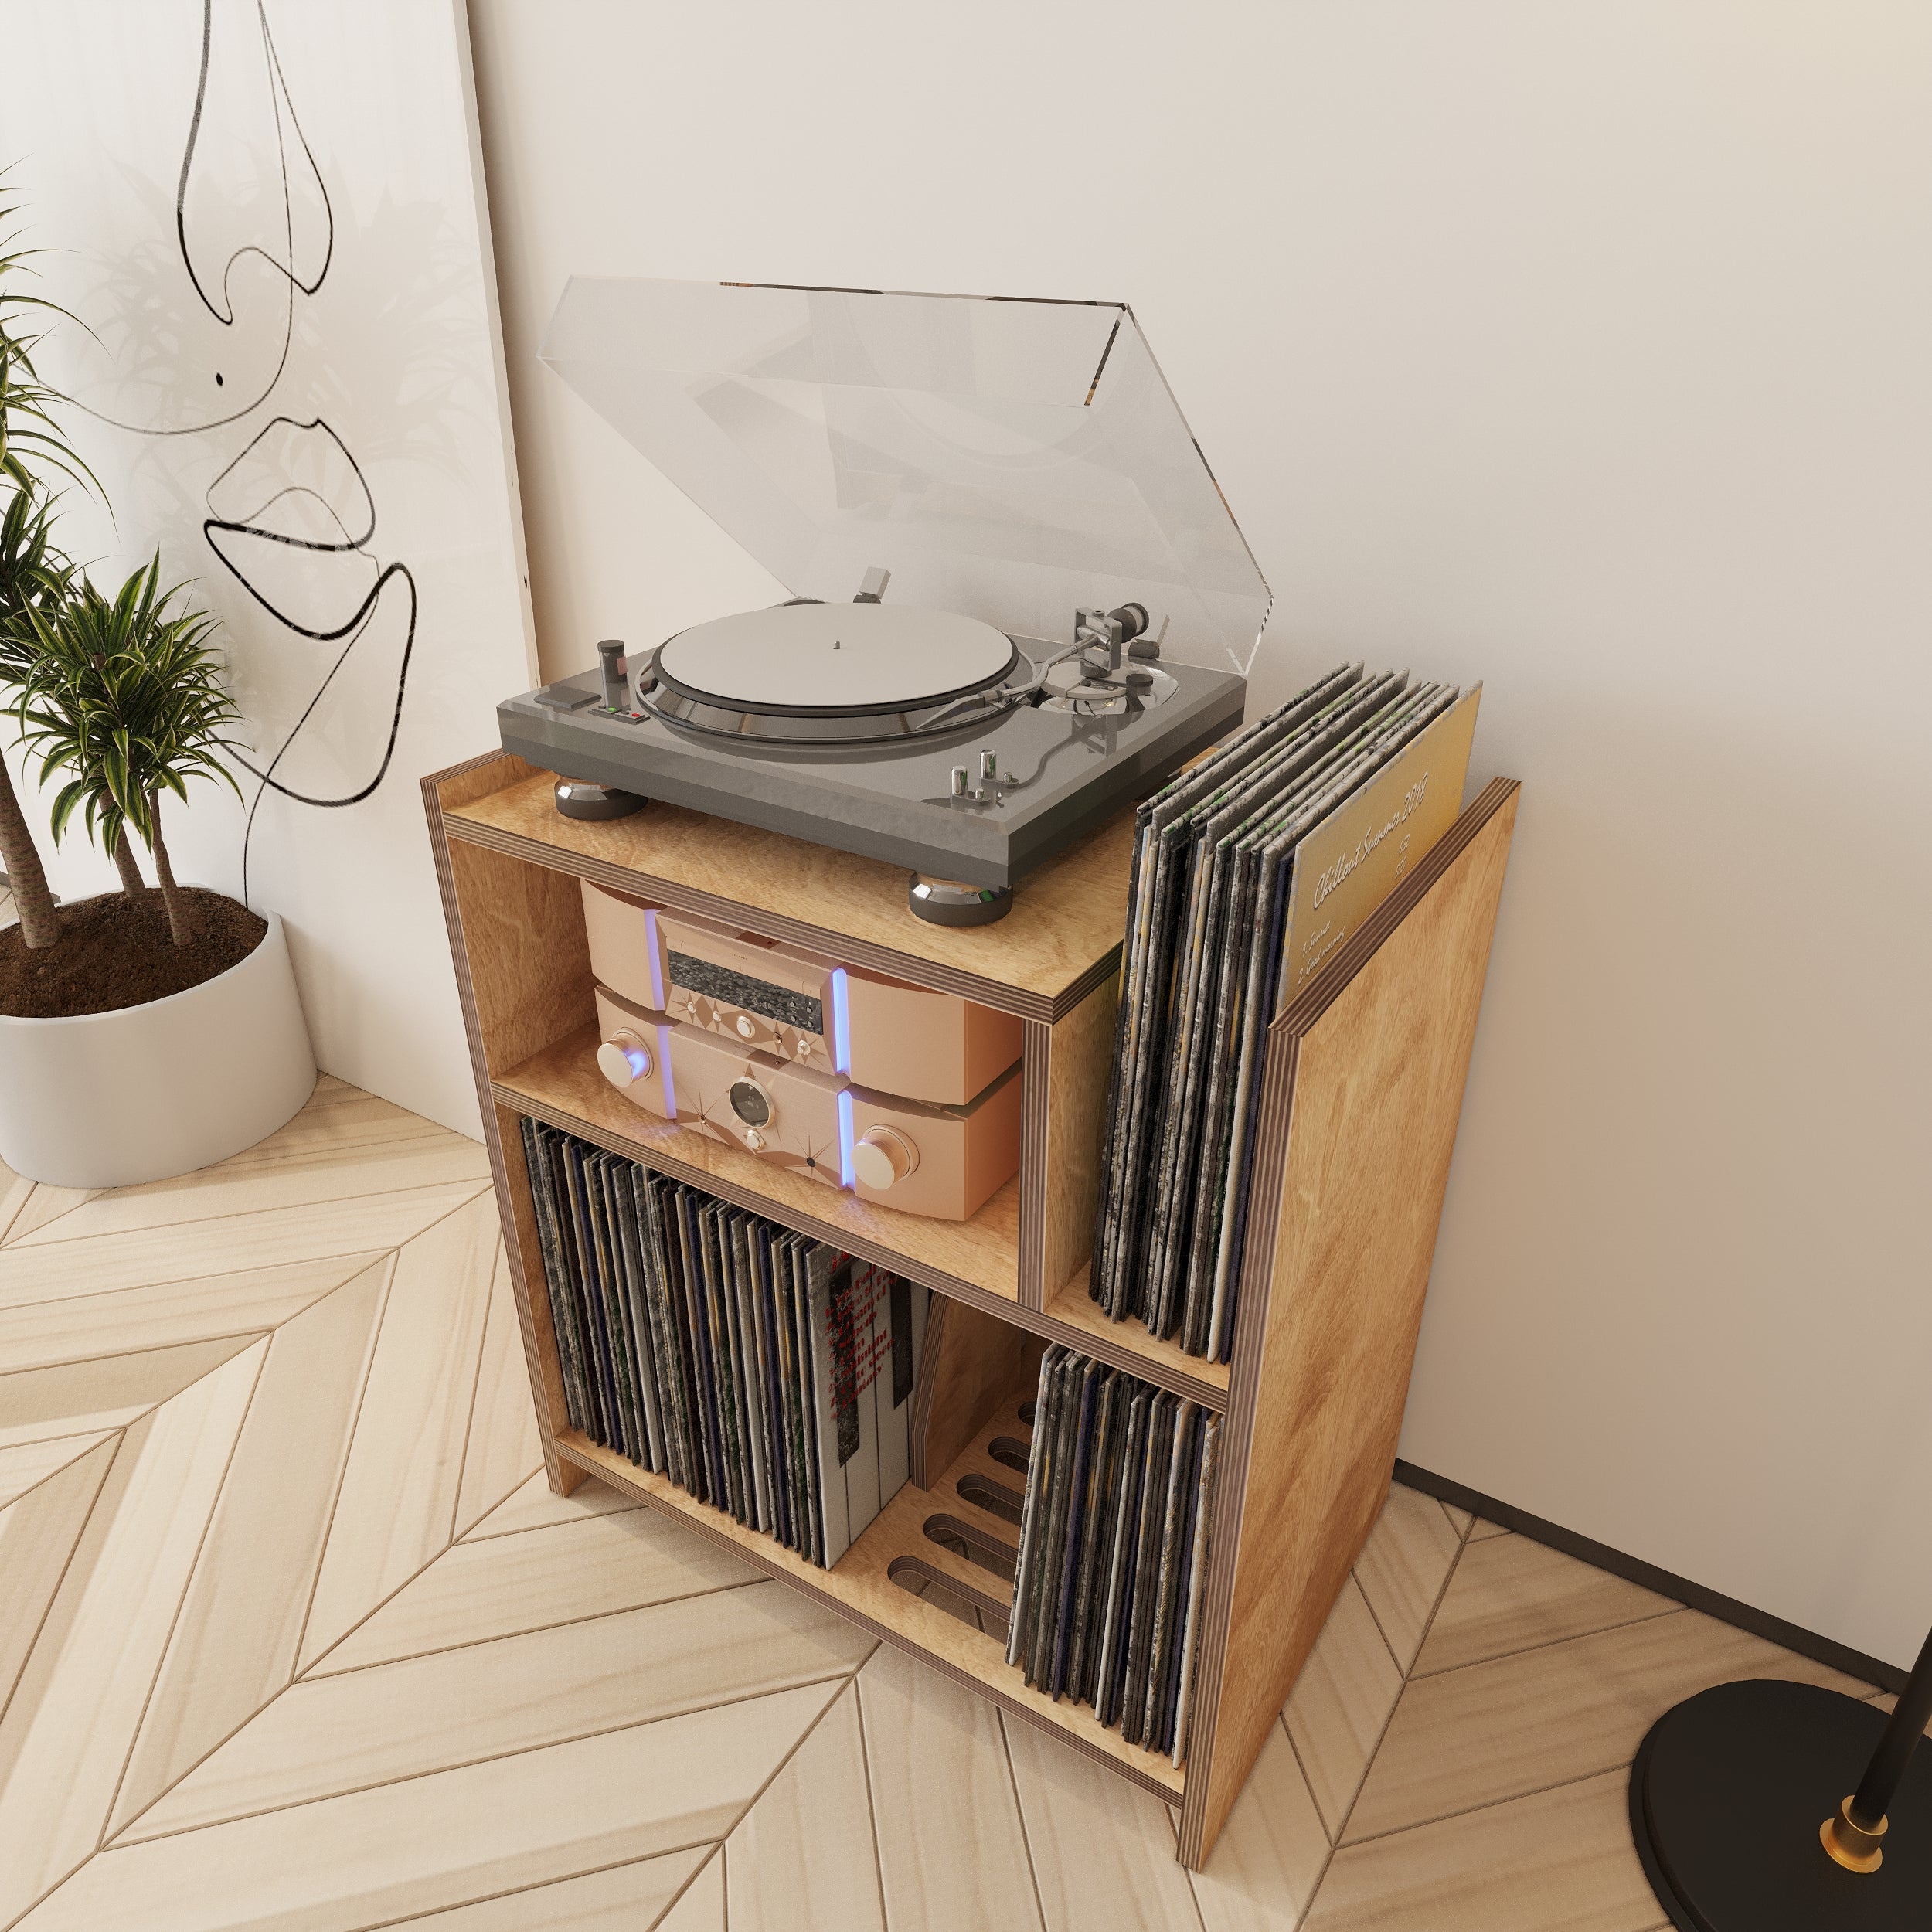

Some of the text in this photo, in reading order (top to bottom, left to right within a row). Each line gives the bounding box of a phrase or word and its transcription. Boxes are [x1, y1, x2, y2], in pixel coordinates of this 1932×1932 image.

[1313, 770, 1428, 910] Chillout Summer 2018
